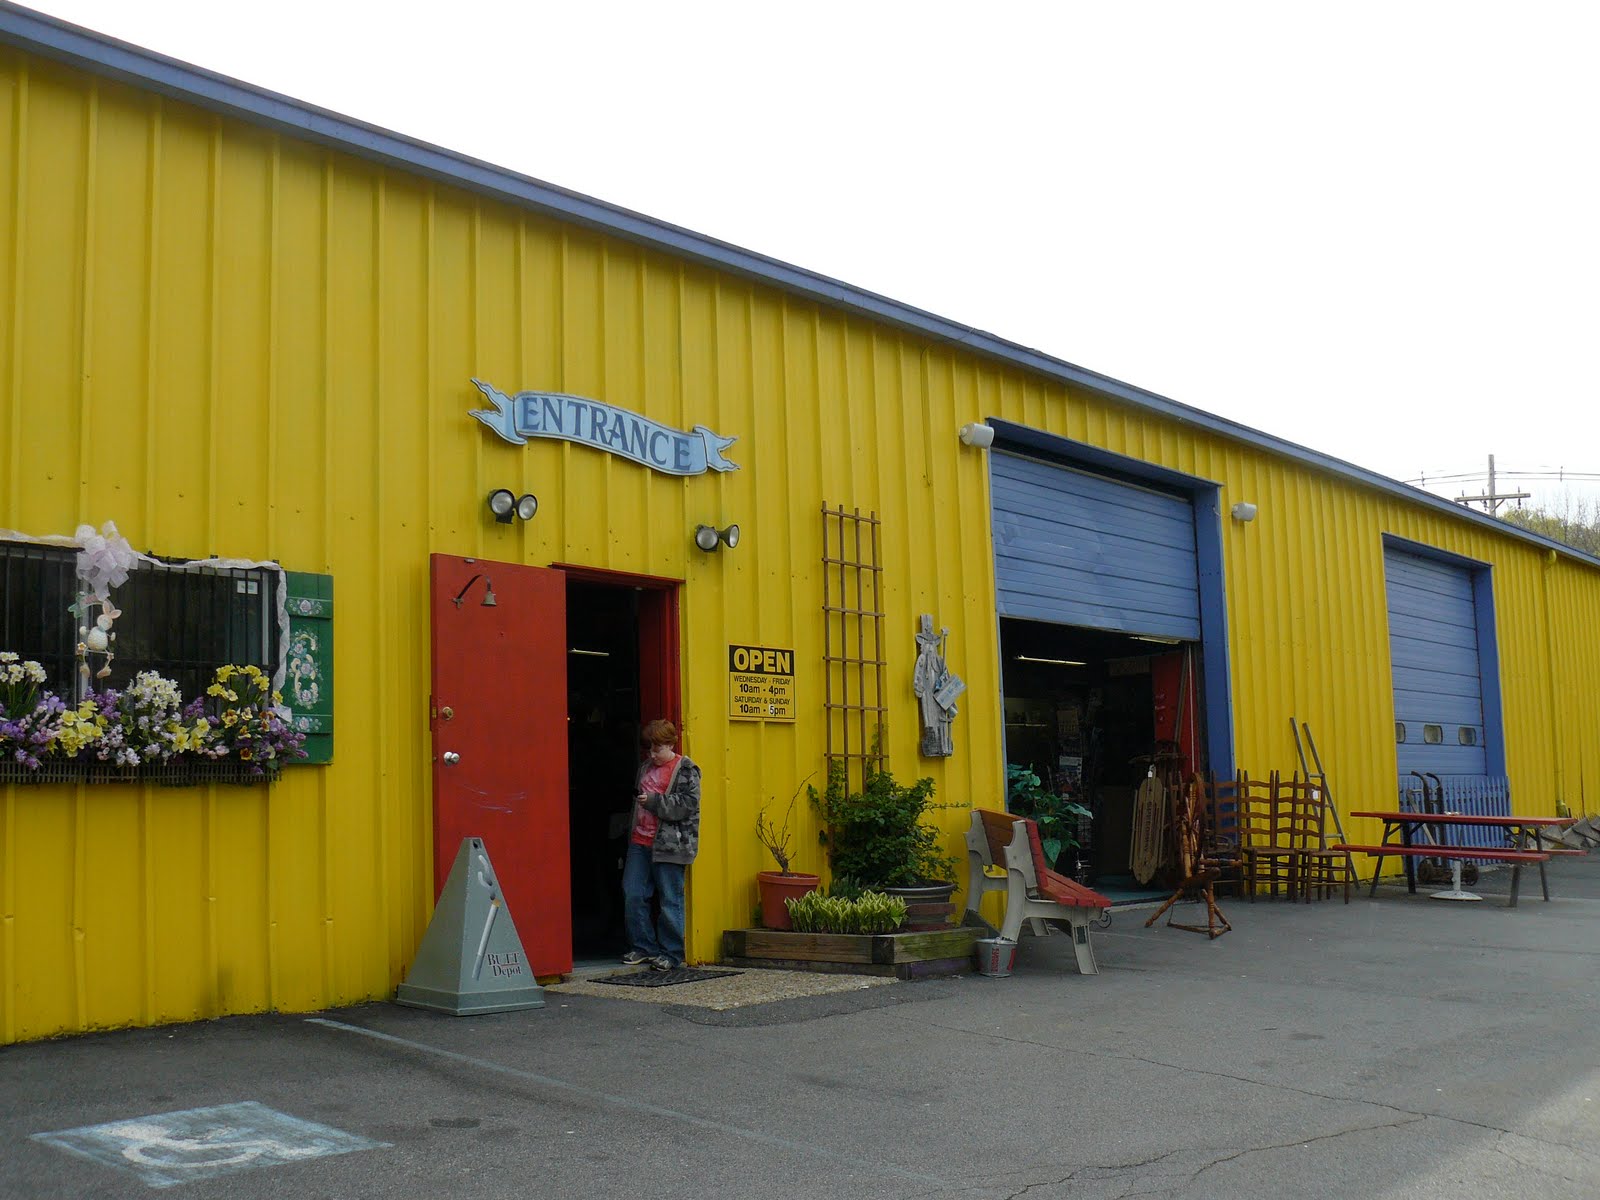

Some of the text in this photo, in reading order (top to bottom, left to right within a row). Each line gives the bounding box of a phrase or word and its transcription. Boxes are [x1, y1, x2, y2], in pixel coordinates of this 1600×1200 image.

[522, 397, 692, 471] ENTRANCE
[733, 648, 791, 673] OPEN
[734, 676, 767, 684] WEDNESDAY
[740, 684, 760, 693] 10am
[769, 686, 785, 696] 4pm
[734, 696, 762, 704] SATURDAY
[740, 704, 760, 713] 10am
[769, 705, 786, 716] 5pm
[488, 953, 519, 965] BUTT
[493, 966, 521, 977] Depot
